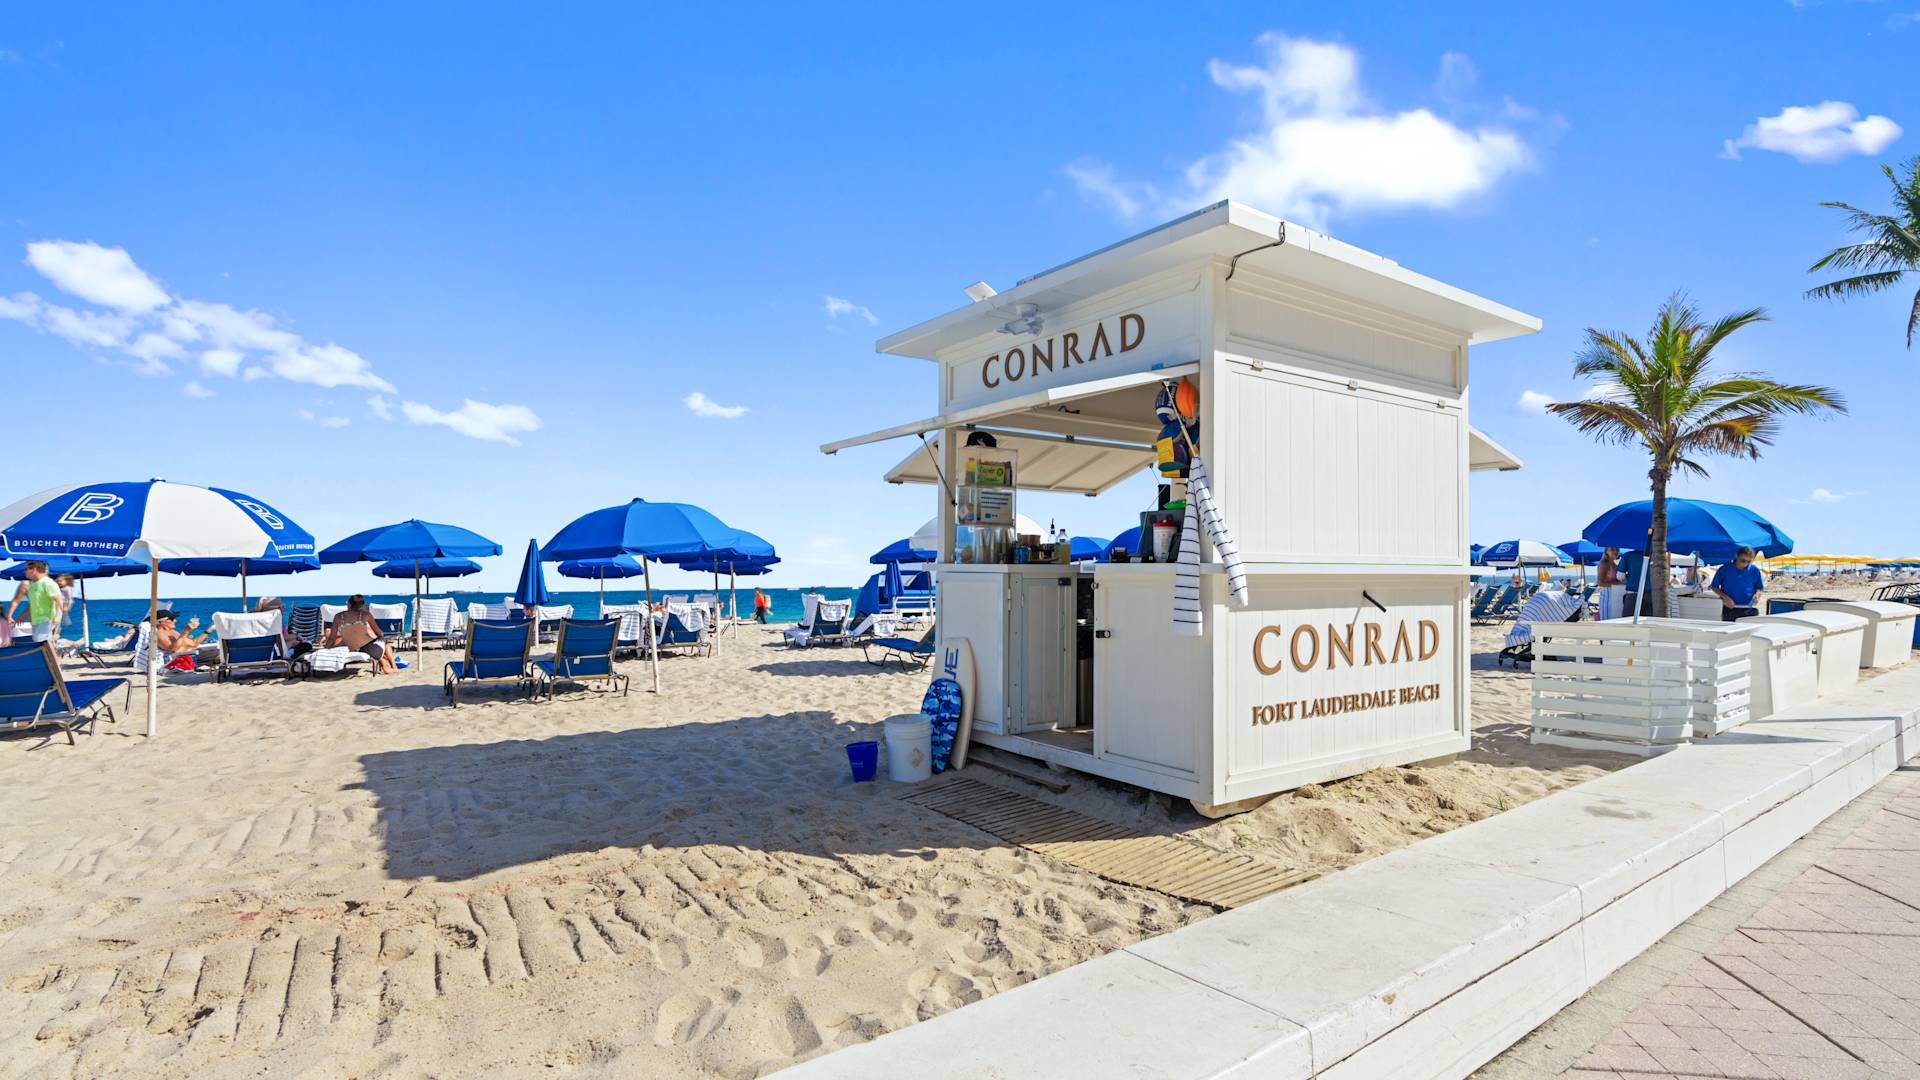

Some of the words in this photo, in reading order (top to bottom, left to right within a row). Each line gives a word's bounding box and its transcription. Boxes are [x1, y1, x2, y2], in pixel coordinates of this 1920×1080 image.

[982, 313, 1146, 388] CONRAD
[73, 541, 124, 550] BROTHERS
[1252, 619, 1440, 676] CONRAD
[1251, 701, 1298, 727] FORT
[1301, 689, 1397, 720] LAUDERDALE
[1399, 683, 1441, 704] BEACH
